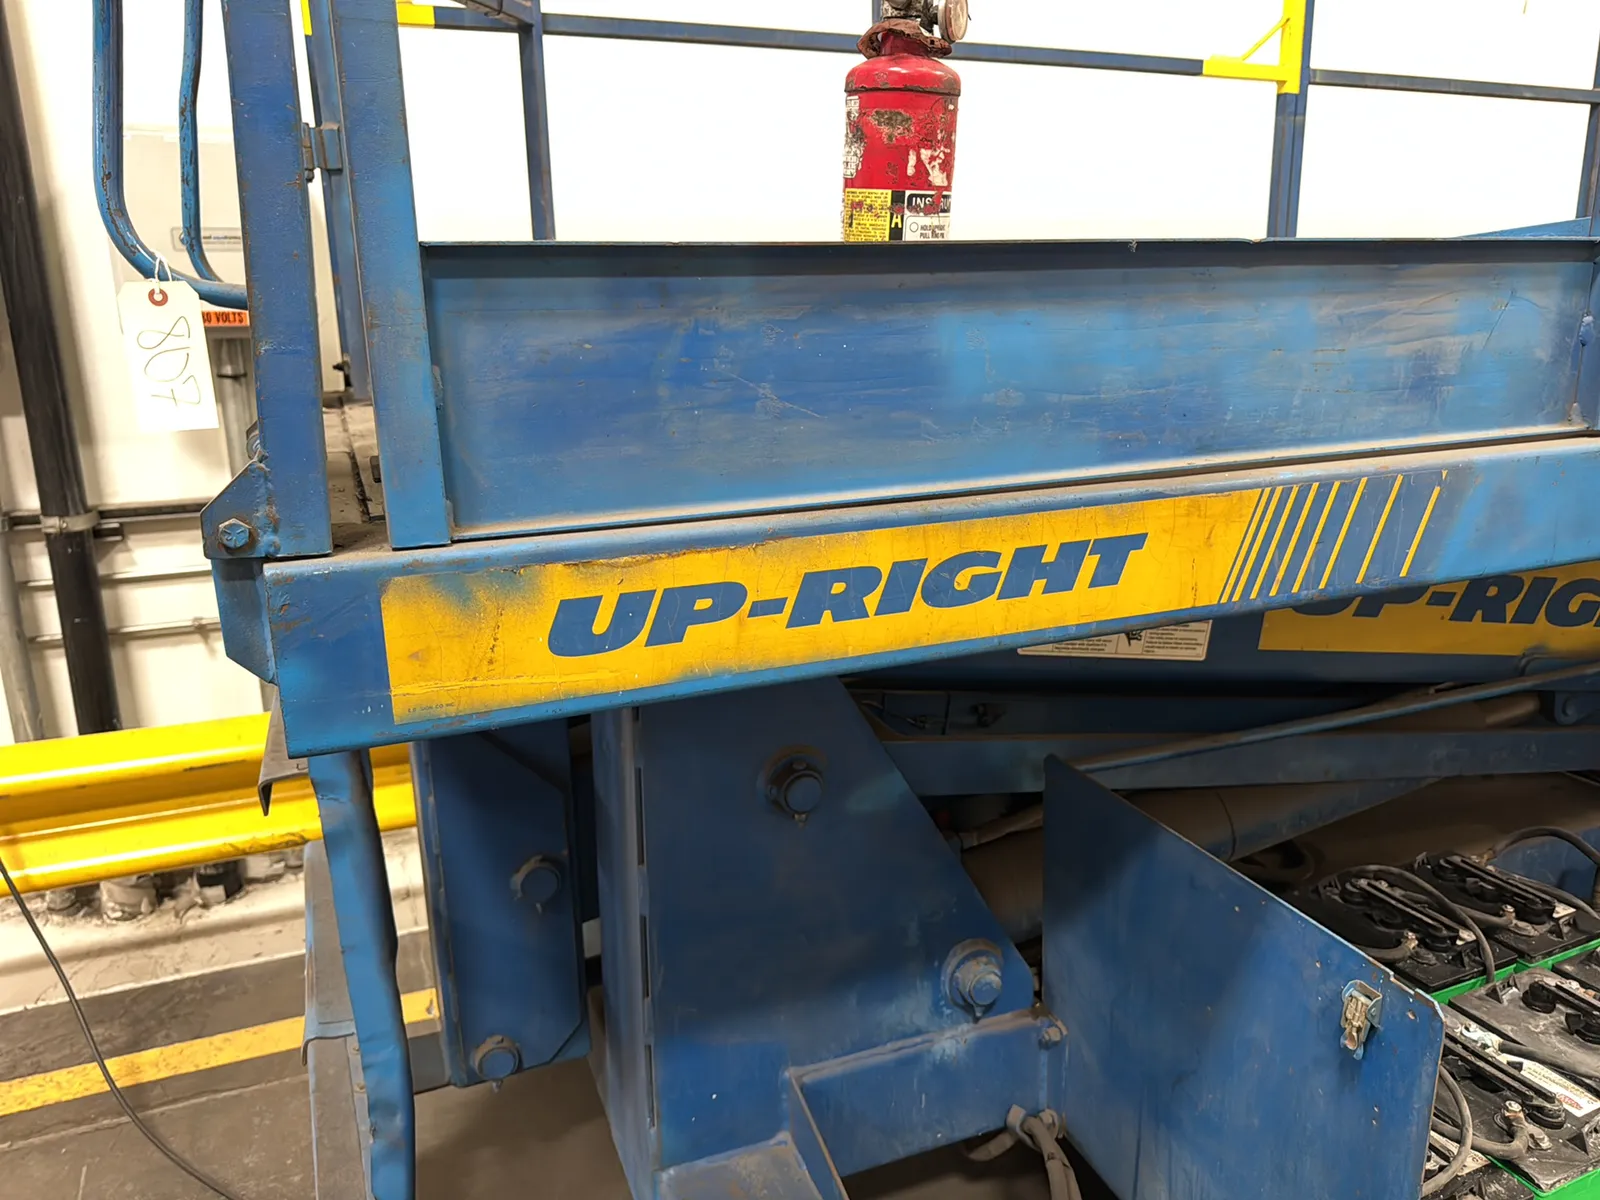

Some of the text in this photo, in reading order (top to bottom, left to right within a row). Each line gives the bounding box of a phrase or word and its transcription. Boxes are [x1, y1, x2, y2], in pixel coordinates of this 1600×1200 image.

[215, 311, 244, 323] VOLTS
[137, 316, 201, 407] 807
[547, 532, 1148, 657] UP-RIGHT
[1292, 575, 1600, 627] P-RIG
